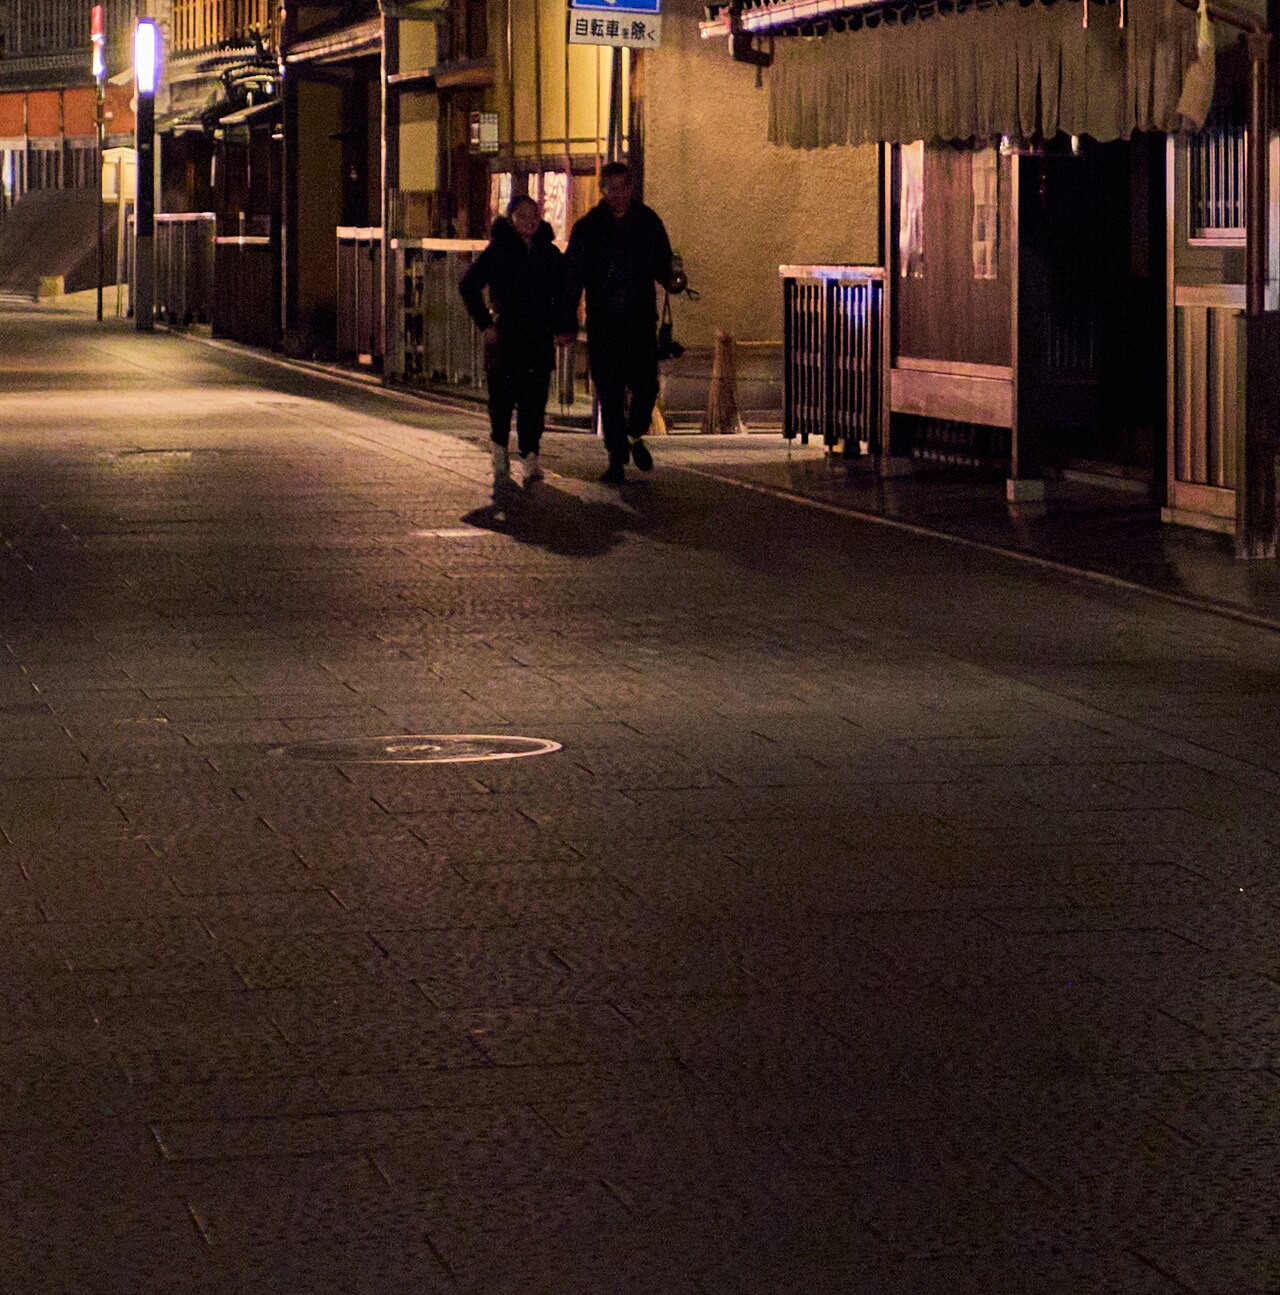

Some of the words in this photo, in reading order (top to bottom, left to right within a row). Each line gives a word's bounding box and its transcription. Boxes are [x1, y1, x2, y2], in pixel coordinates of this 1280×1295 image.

[575, 18, 655, 41] 自転車を除く
